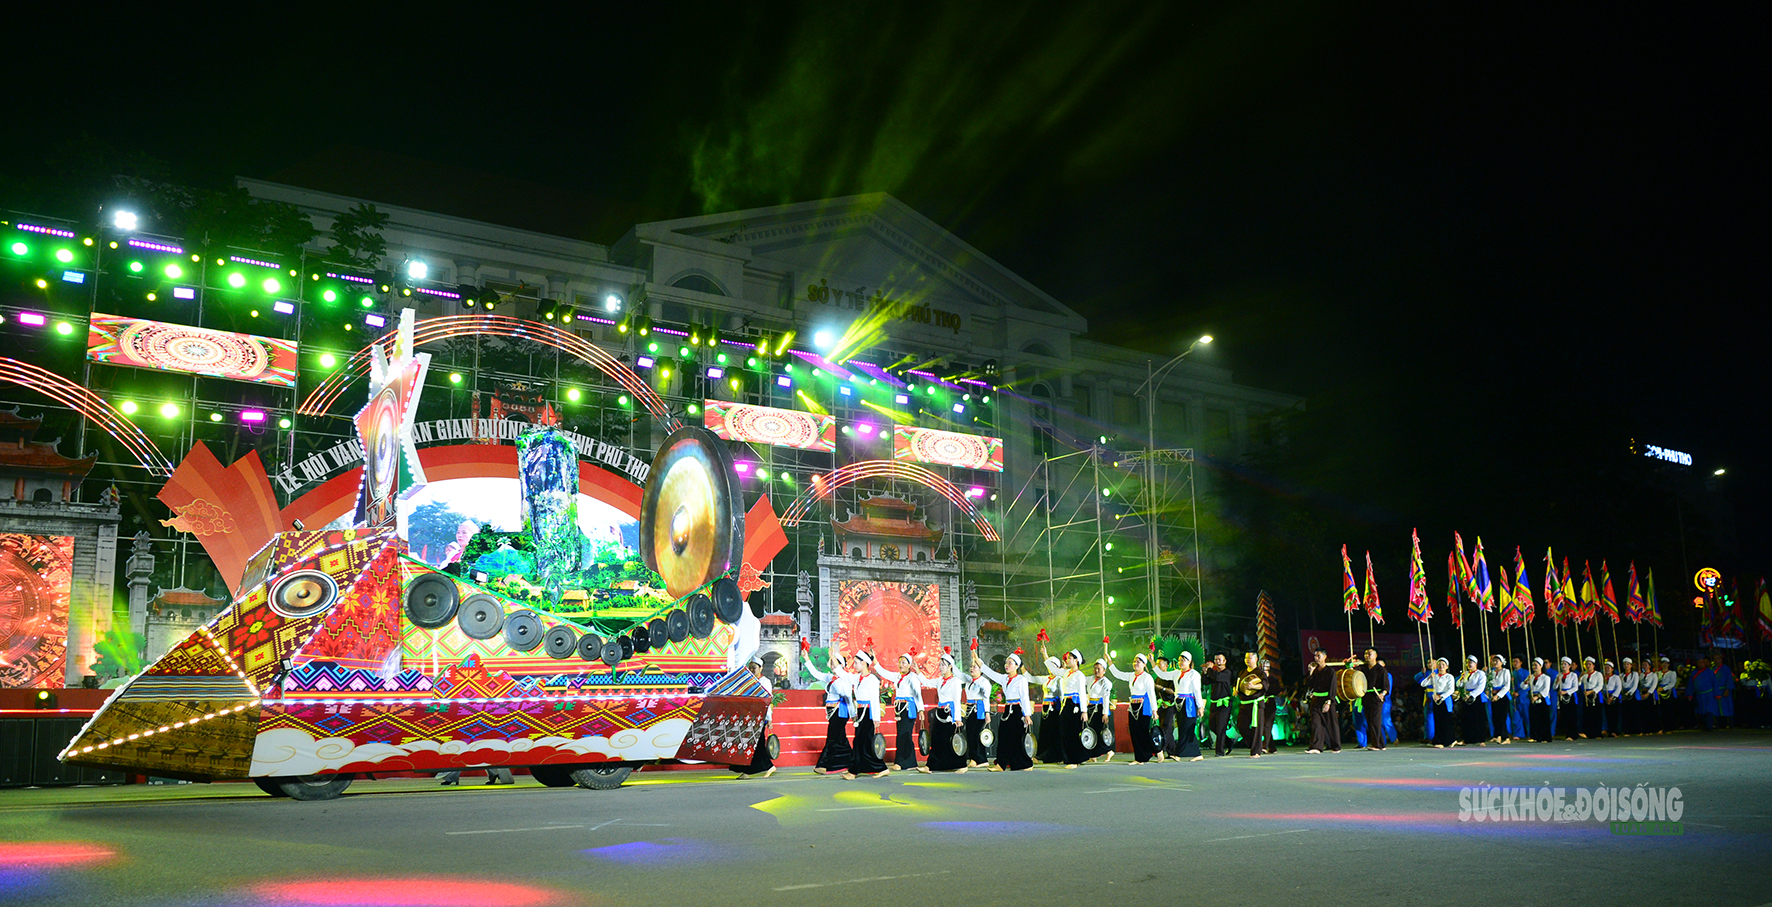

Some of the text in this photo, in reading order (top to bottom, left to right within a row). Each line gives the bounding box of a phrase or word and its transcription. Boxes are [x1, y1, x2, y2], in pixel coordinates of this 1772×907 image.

[807, 278, 829, 304] SỞ
[831, 288, 844, 307] Y
[845, 286, 866, 312] TẾ
[933, 309, 961, 335] THỌ
[276, 462, 303, 494] LỄ
[299, 452, 331, 482] HỘI
[327, 438, 364, 468] VĂN
[436, 419, 473, 441] GIAN
[596, 441, 624, 467] PHÚ
[625, 454, 651, 484] THỌ
